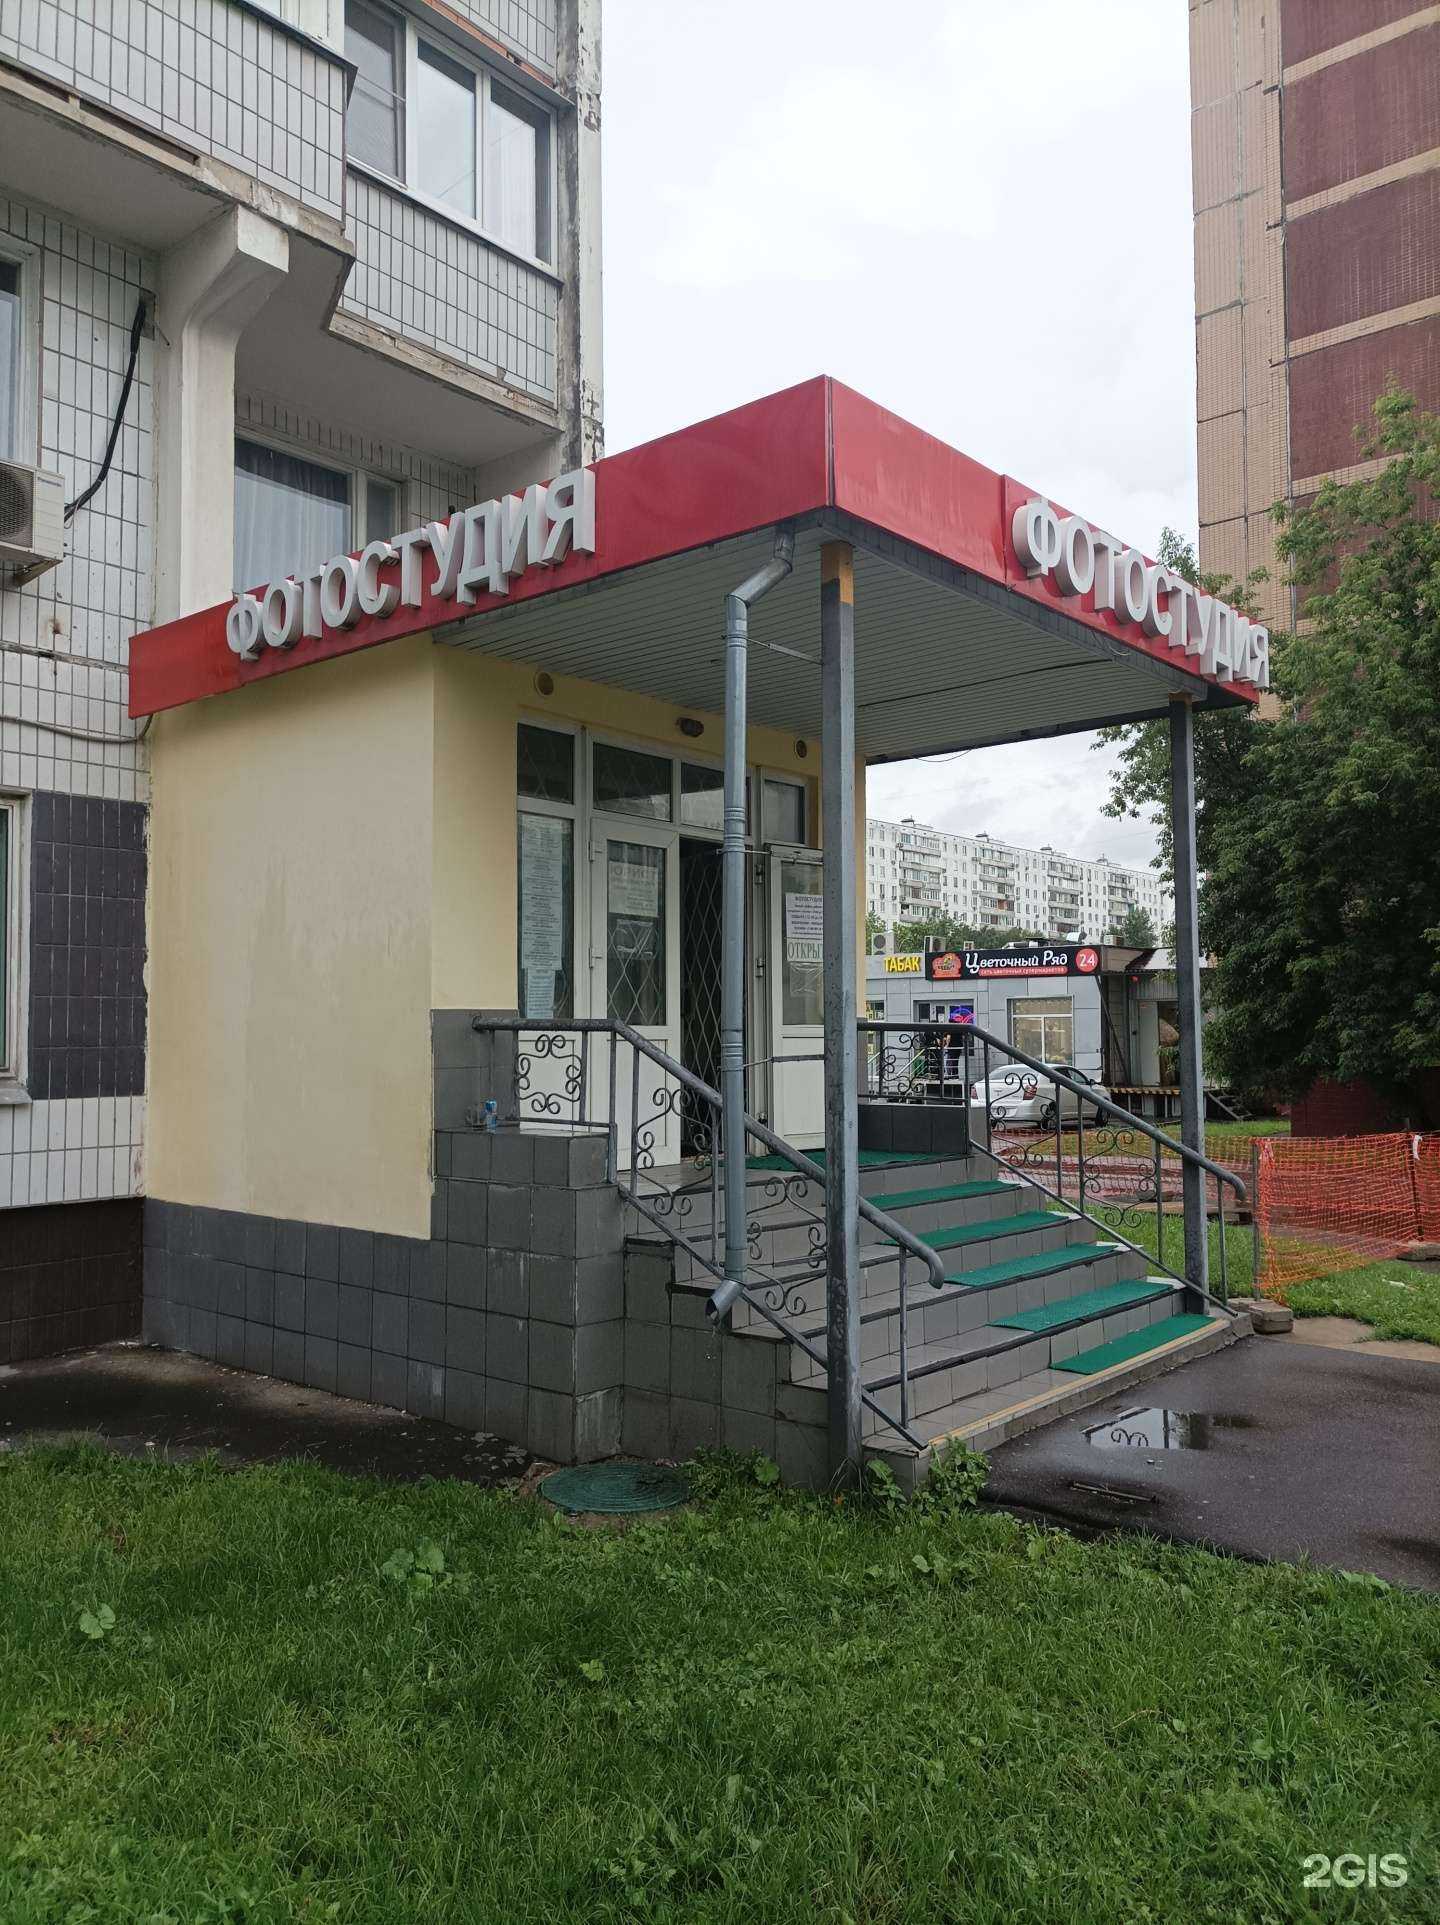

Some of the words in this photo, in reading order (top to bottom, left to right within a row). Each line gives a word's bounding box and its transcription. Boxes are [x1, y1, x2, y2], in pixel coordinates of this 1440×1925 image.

[225, 467, 596, 662] ФОТОСТУДИЯ
[1011, 497, 1270, 688] ФОТОСТУДИЯ
[788, 942, 823, 959] ОТКРЫ
[1079, 953, 1096, 968] 24
[884, 956, 920, 973] ТАБАК
[965, 952, 1039, 974] Цветочный
[1043, 950, 1068, 965] Ряд
